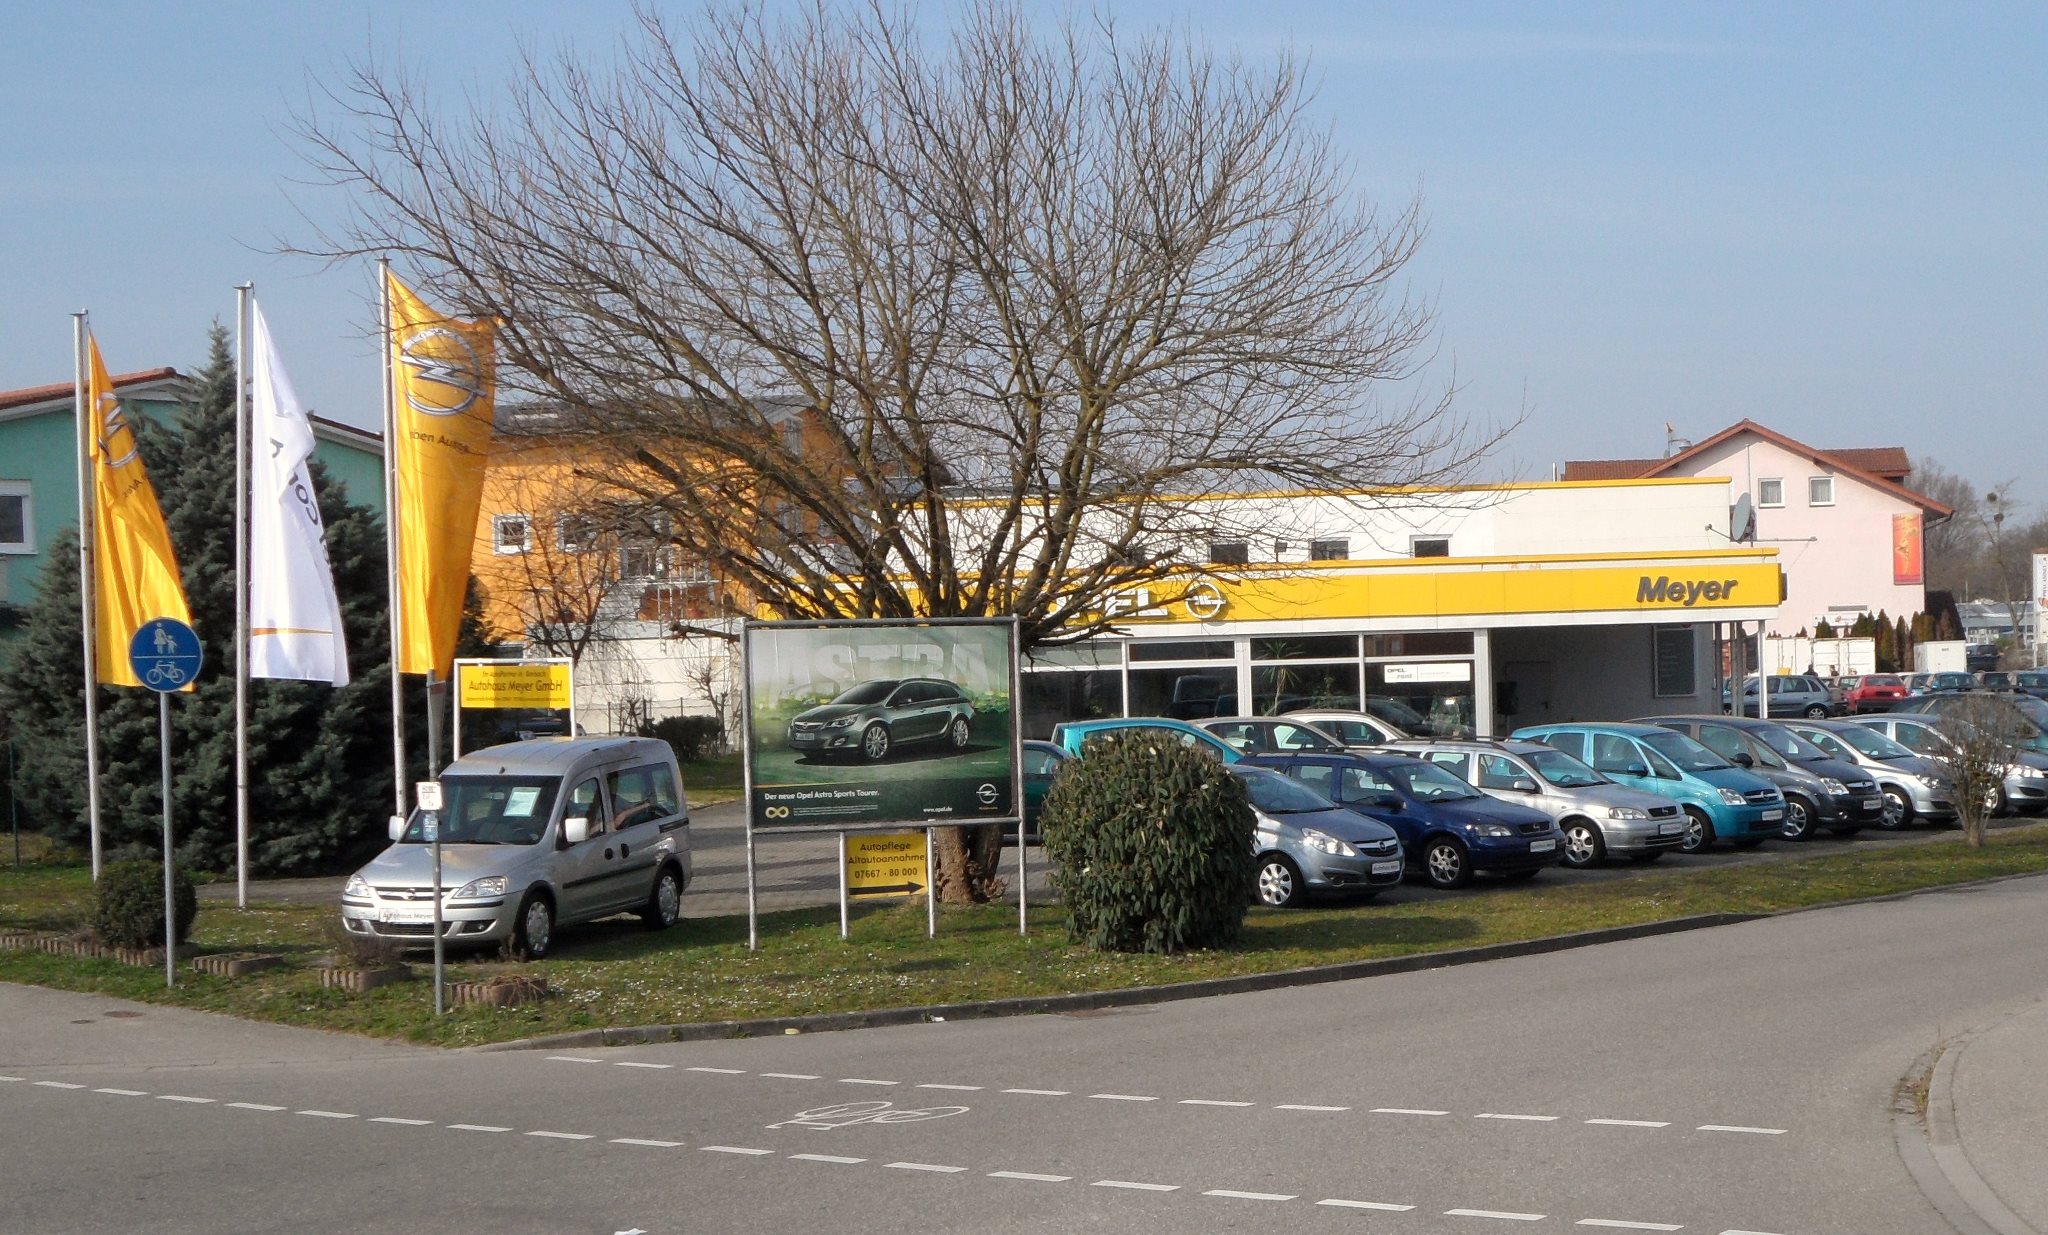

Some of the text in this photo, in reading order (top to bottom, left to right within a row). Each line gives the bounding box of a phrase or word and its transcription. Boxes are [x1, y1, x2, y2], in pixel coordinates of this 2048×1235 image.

[1636, 576, 1738, 606] Meyer
[469, 680, 563, 693] Autohaus Meyer GmbH
[796, 791, 813, 800] Opel
[814, 791, 832, 799] Astra
[833, 790, 855, 799] Sports
[856, 789, 880, 797] Tourer.
[860, 842, 911, 853] Autopflege
[848, 853, 925, 865] Altautoannahme
[854, 869, 880, 879] 07667
[889, 868, 899, 877] 80
[902, 867, 918, 876] 000
